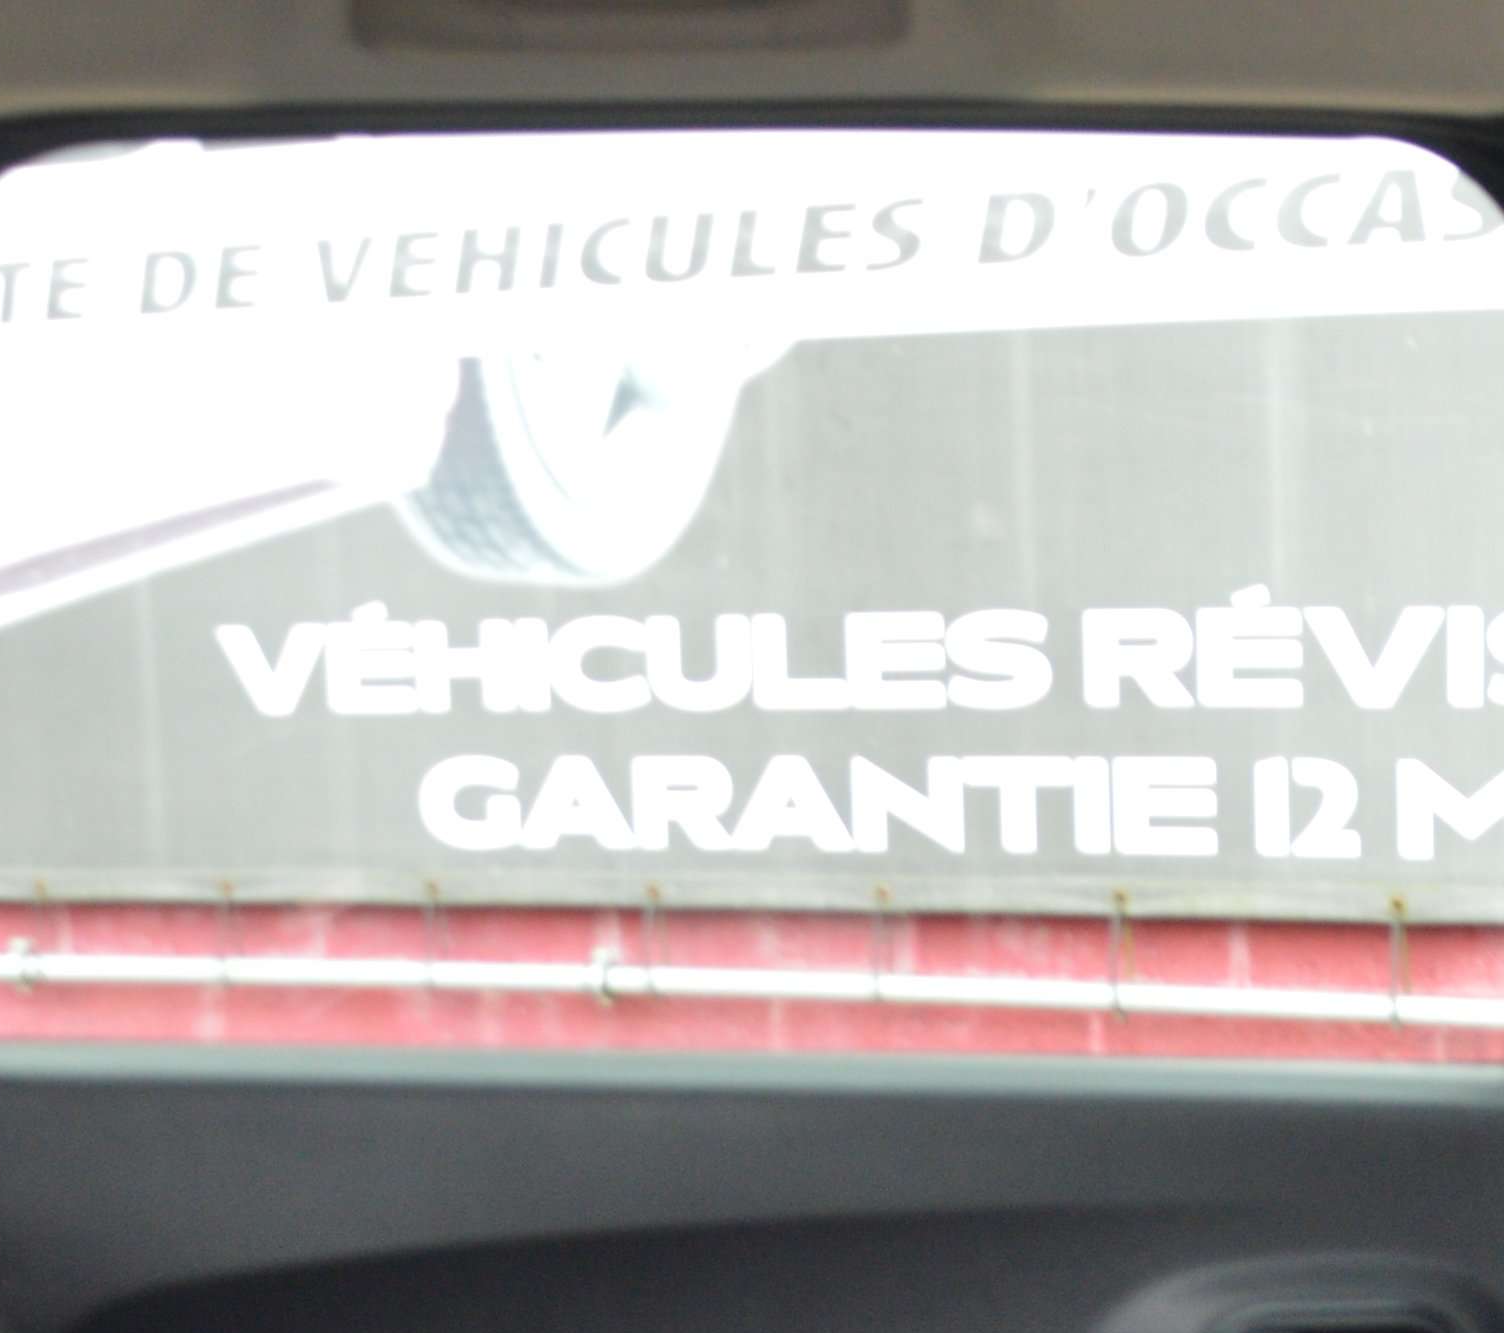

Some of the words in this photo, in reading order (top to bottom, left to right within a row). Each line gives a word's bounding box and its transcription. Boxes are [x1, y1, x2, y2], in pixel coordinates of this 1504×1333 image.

[140, 245, 261, 314] DE
[317, 198, 924, 302] VEHICULES
[213, 599, 1055, 717] VÉHICULES
[417, 754, 1219, 857] GARANTIE
[1253, 755, 1362, 858] 12
